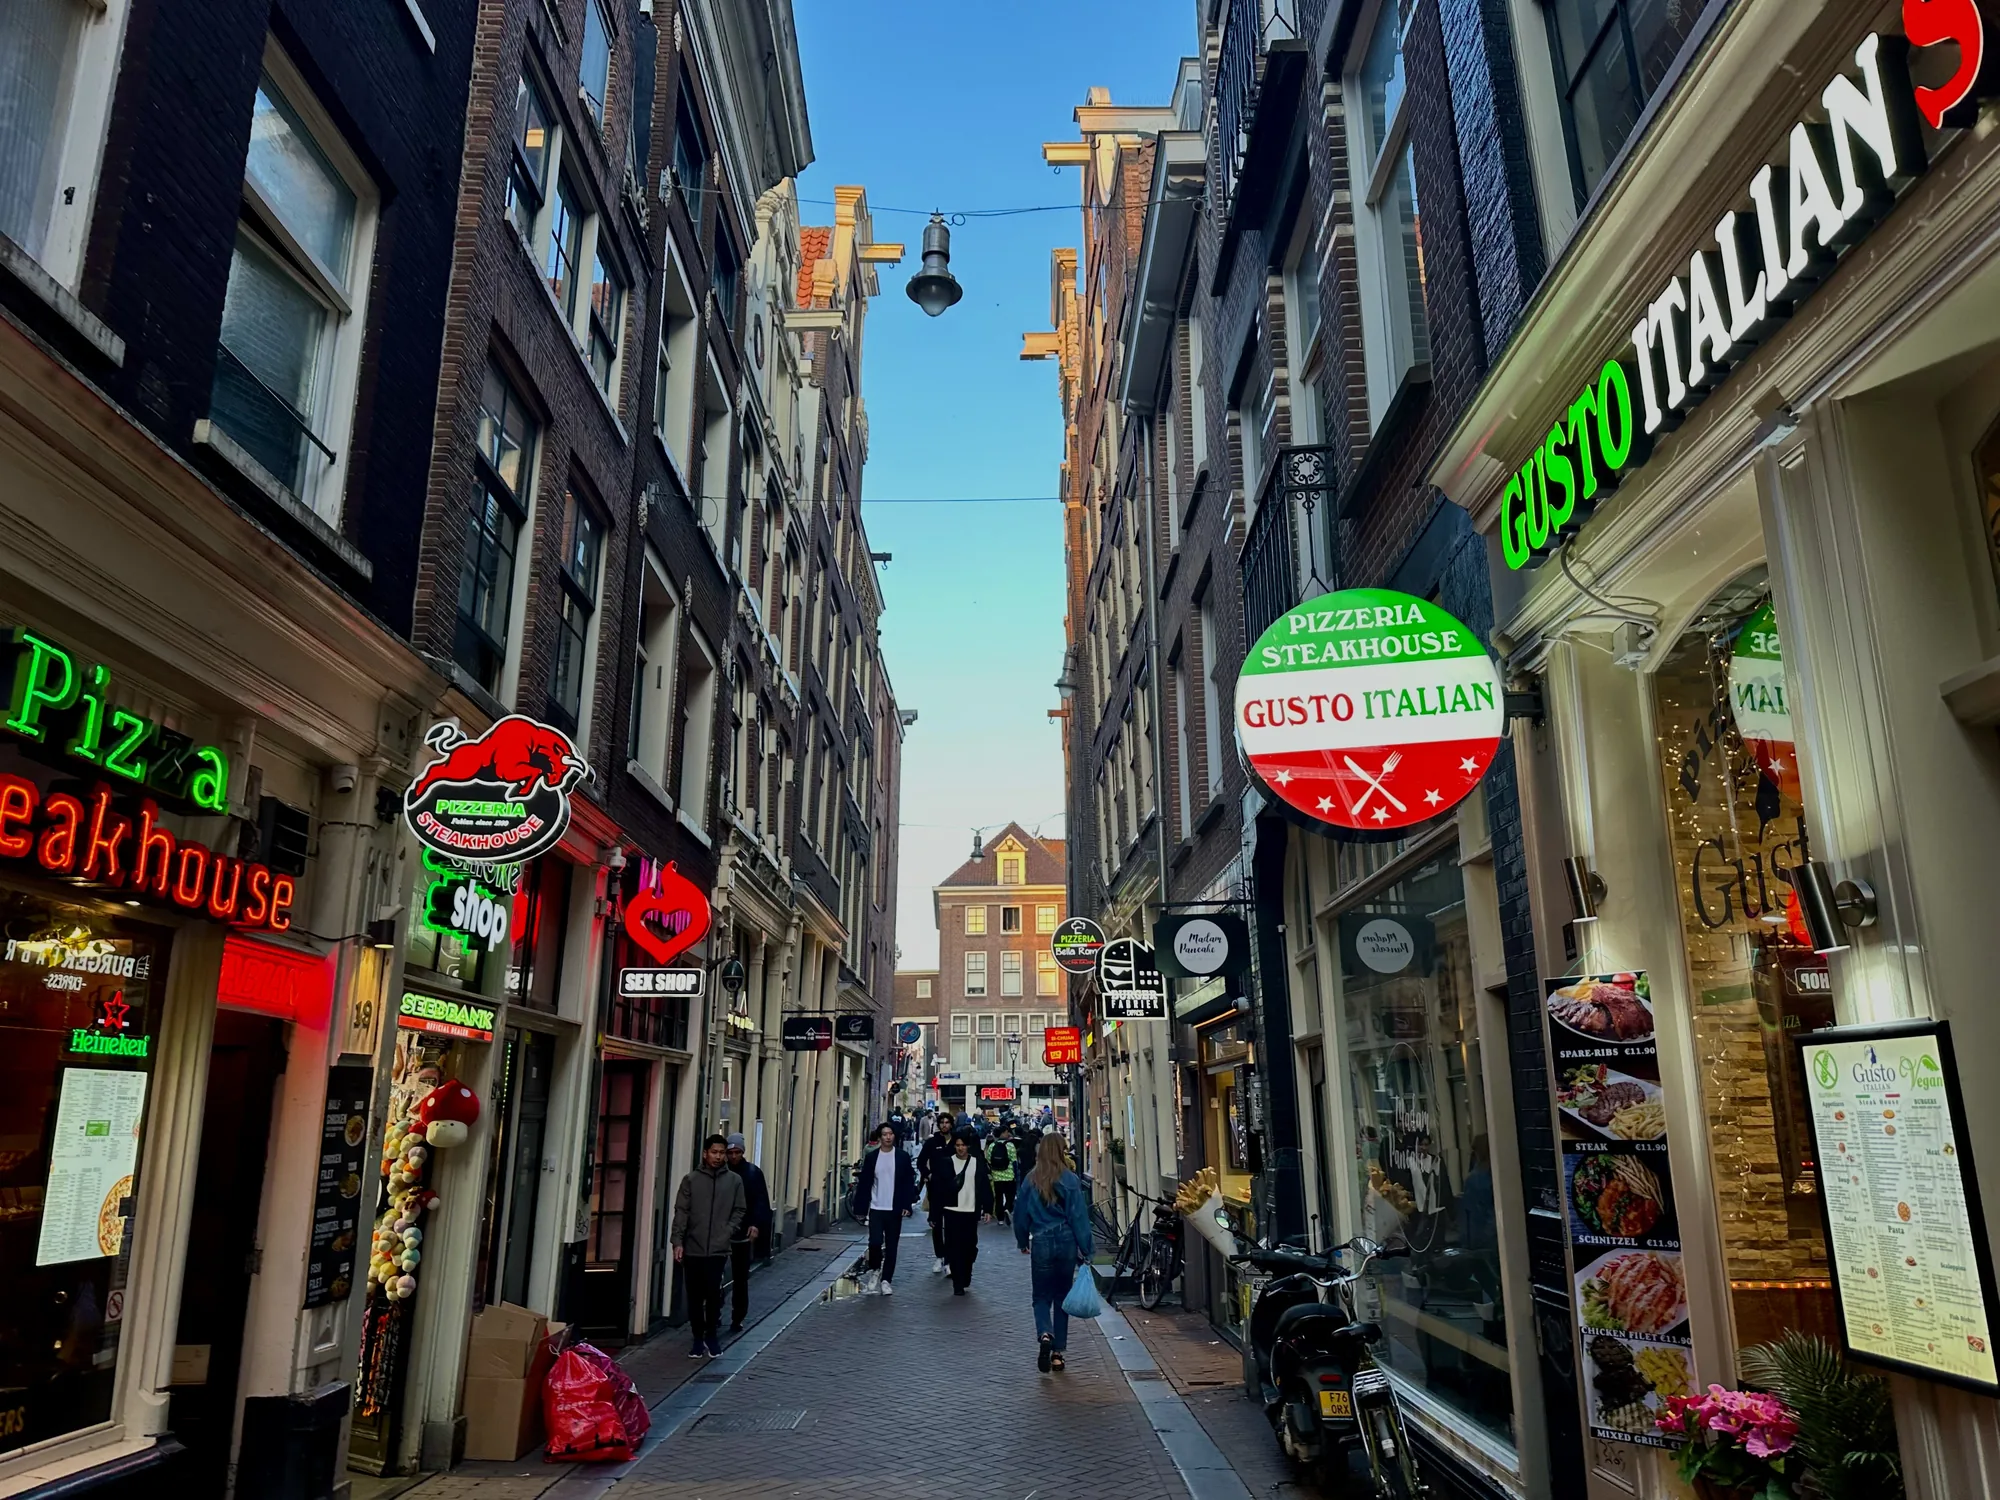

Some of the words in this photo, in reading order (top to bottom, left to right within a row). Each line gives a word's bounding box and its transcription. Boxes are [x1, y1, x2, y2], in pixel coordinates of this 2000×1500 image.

[1500, 359, 1633, 571] GUSTO
[1630, 31, 1897, 435] ITALIAN
[1288, 603, 1426, 635] PIZZERIA
[1261, 630, 1463, 669] STEAKHOUSE
[1243, 692, 1355, 728] GUSTO
[1362, 681, 1496, 720] ITALIAN
[435, 799, 527, 818] PIZZERIA
[416, 811, 545, 849] STEAKHOUSE
[450, 878, 507, 952] shop
[1060, 934, 1097, 944] PIZZERIA
[1188, 931, 1222, 944] Madam
[1055, 947, 1076, 956] Bella
[1179, 942, 1216, 954] Pancake
[624, 971, 653, 991] SEX
[655, 971, 697, 991] SHOP
[1111, 989, 1158, 1000] BURGER
[353, 999, 373, 1029] 19
[400, 992, 495, 1030] SEEDBANK
[1111, 1000, 1159, 1009] FABRIEK
[425, 1021, 450, 1033] OFFICIAL
[69, 1027, 150, 1057] Heineken
[1559, 1047, 1619, 1059] SPARE-RIBS
[1624, 1046, 1656, 1055] €11.90
[1852, 1062, 1896, 1083] Gusto
[1899, 1055, 1944, 1091] Vegan
[1862, 1083, 1892, 1092] ITALIAN
[1575, 1143, 1608, 1151] STEAK
[1635, 1143, 1667, 1152] €11.90
[1887, 1225, 1905, 1235] Pasta
[1578, 1235, 1638, 1246] SCHNITZEL
[1646, 1239, 1680, 1248] €11.90
[1580, 1326, 1626, 1338] CHICKEN
[1628, 1330, 1658, 1342] FILET
[1660, 1334, 1692, 1346] €11.90
[1597, 1429, 1632, 1442] MIXED
[1634, 1435, 1667, 1448] GRILL
